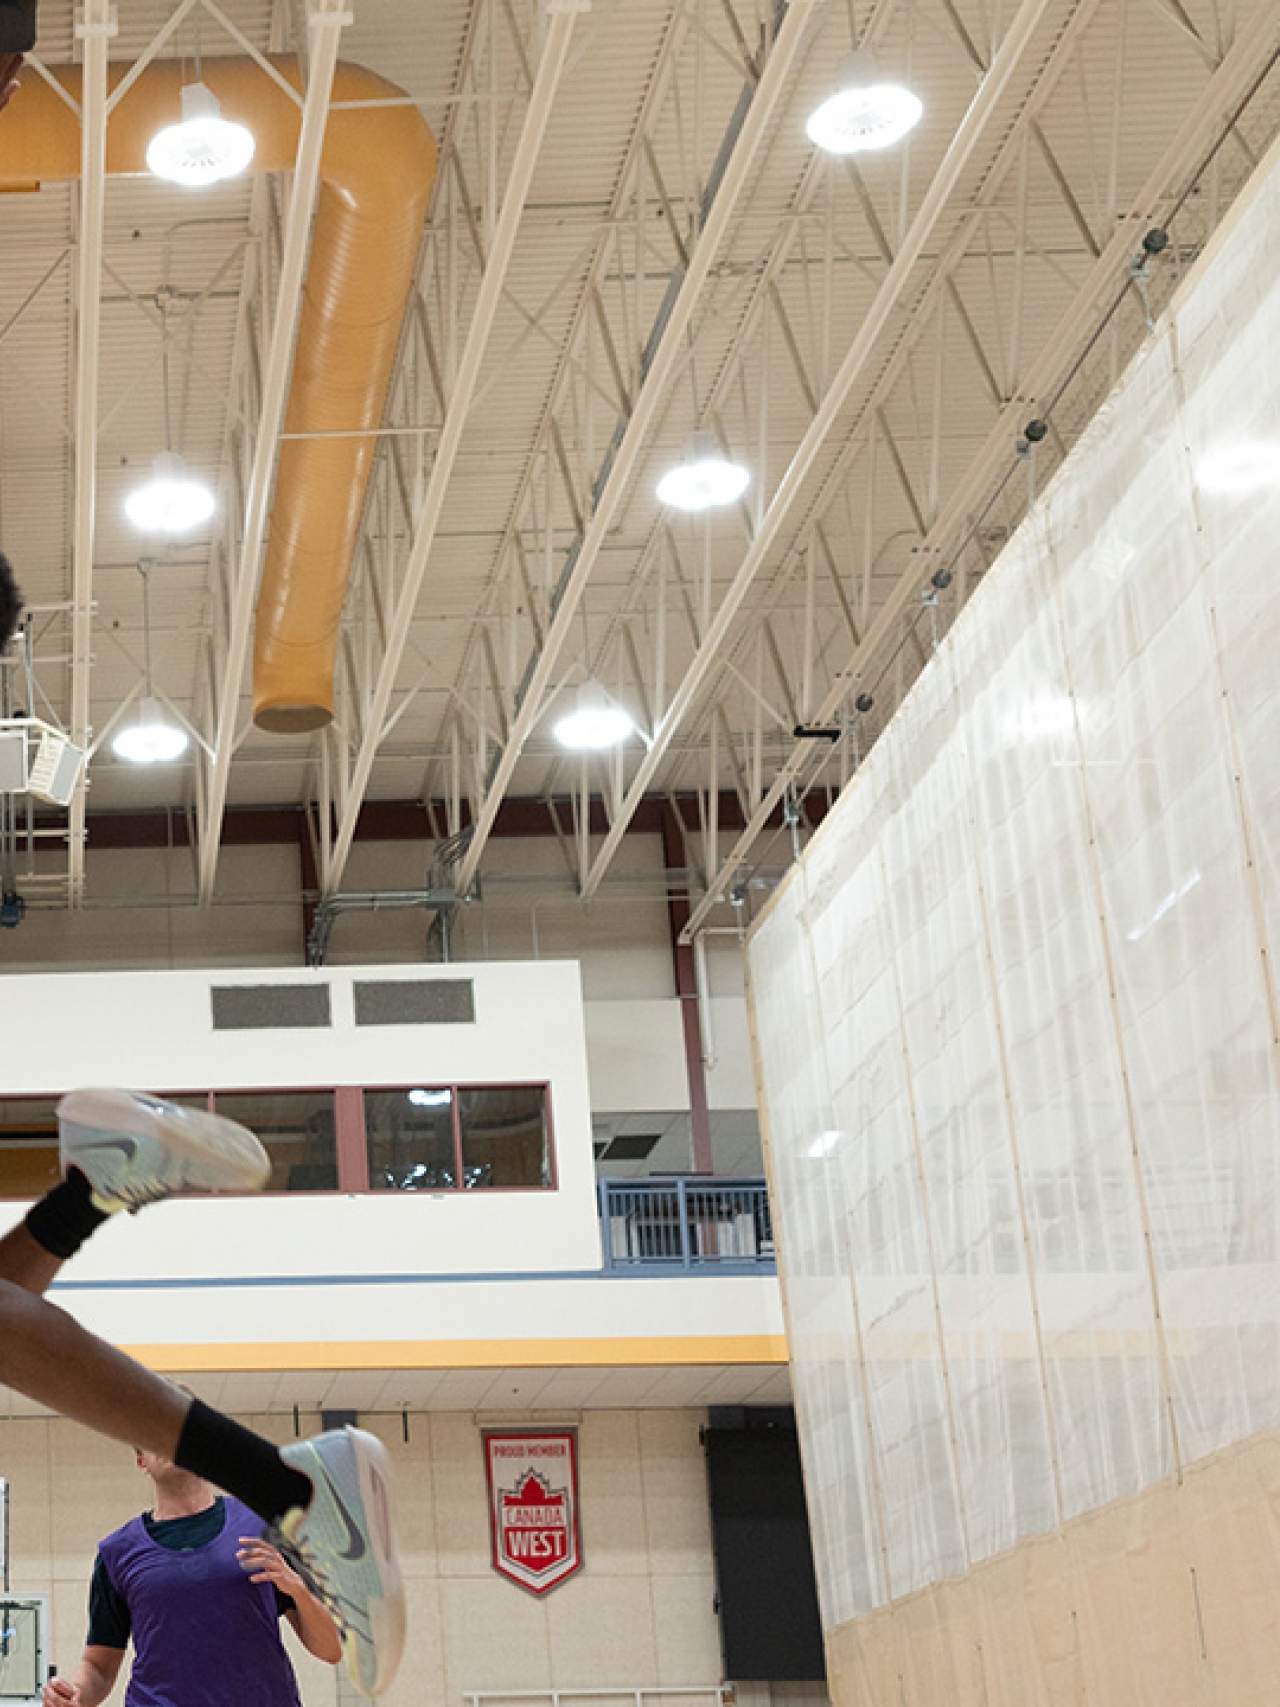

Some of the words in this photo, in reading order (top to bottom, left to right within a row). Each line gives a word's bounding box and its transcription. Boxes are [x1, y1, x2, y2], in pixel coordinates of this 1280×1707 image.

[494, 1445, 524, 1458] PROUD
[527, 1444, 566, 1457] MEMBER
[505, 1507, 563, 1526] CANADA
[508, 1531, 564, 1556] WEST
